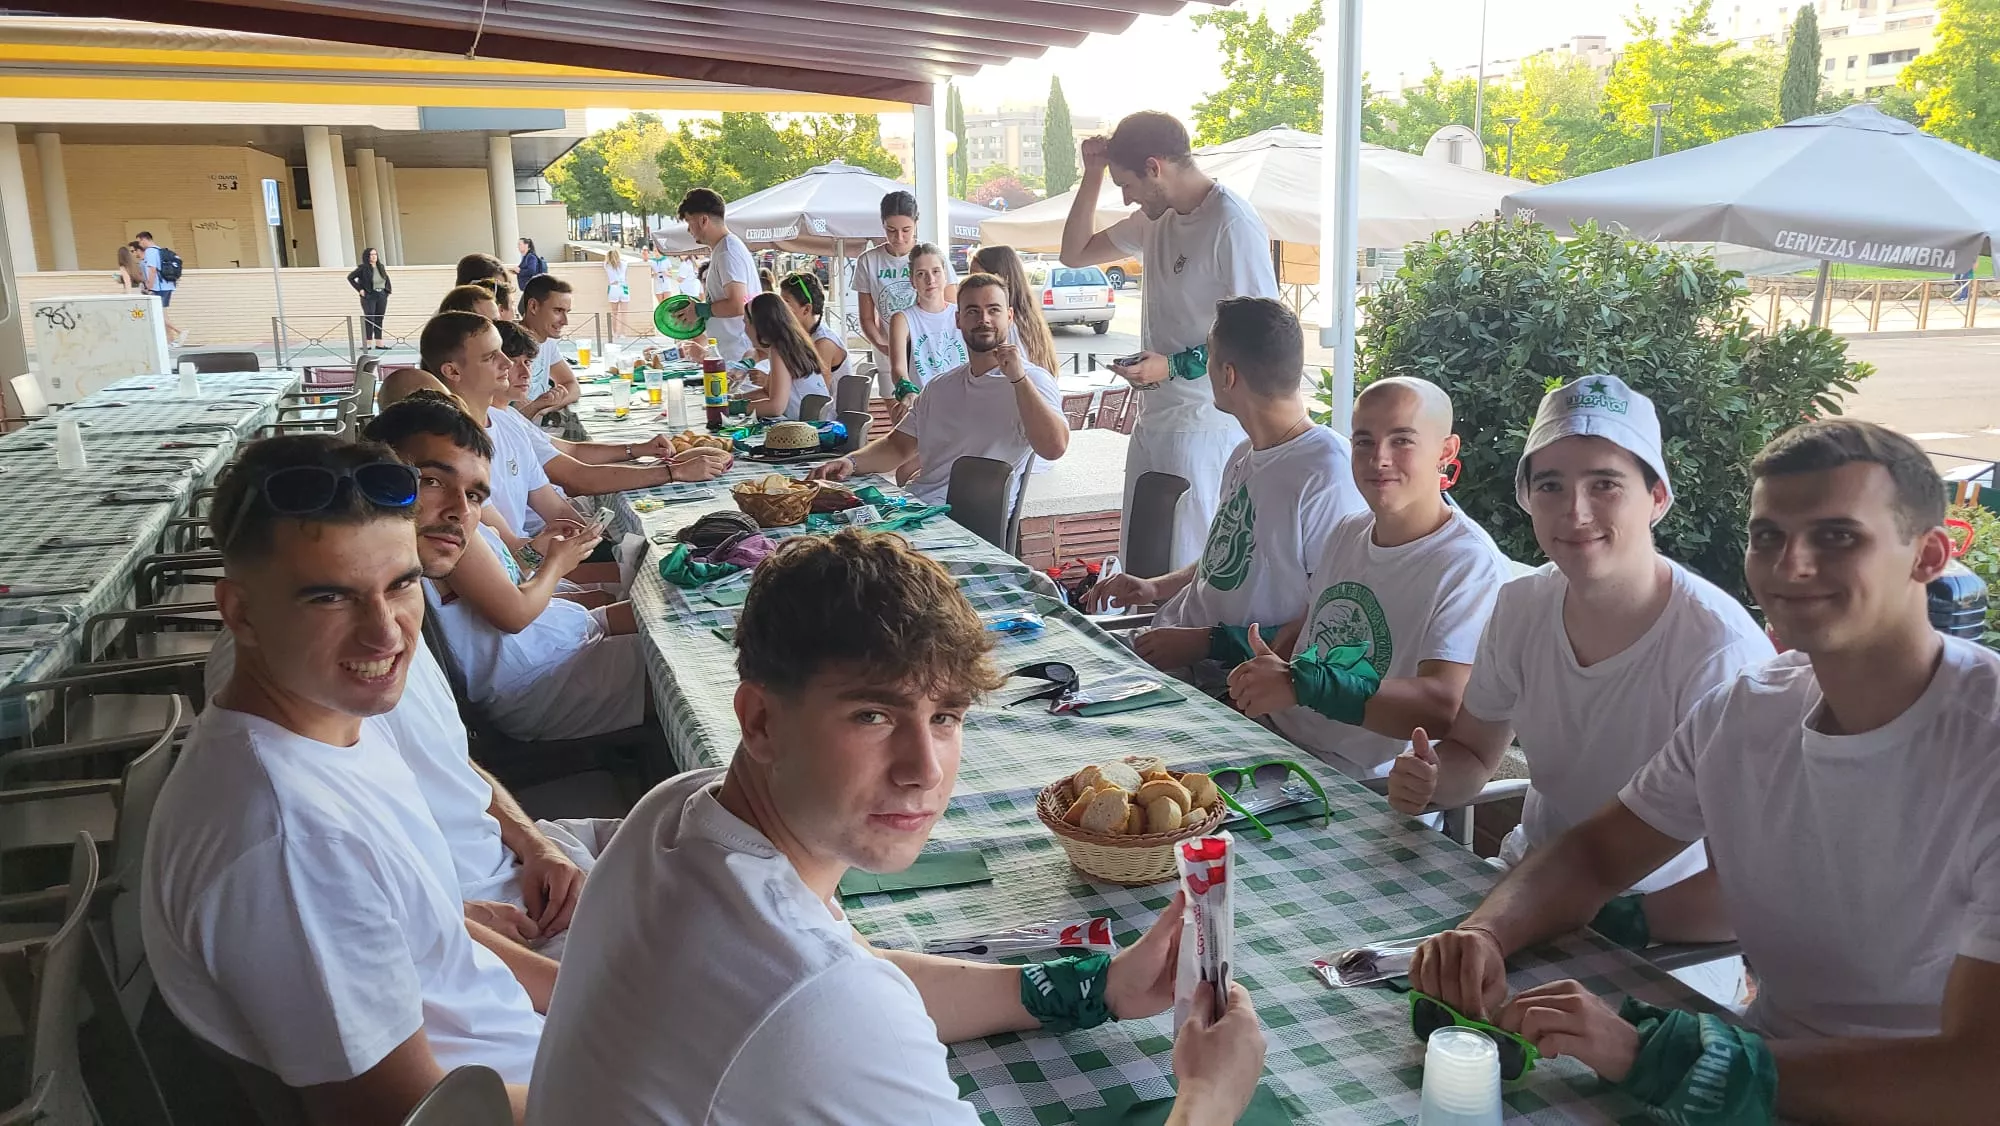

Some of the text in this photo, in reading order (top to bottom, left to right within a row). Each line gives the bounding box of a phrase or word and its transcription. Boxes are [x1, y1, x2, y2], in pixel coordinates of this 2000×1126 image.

[746, 227, 772, 239] CERVEZAS
[954, 225, 980, 238] CERVEZ
[1774, 230, 1956, 269] CERVEZAS ALHAMBRA
[877, 268, 897, 279] JAI
